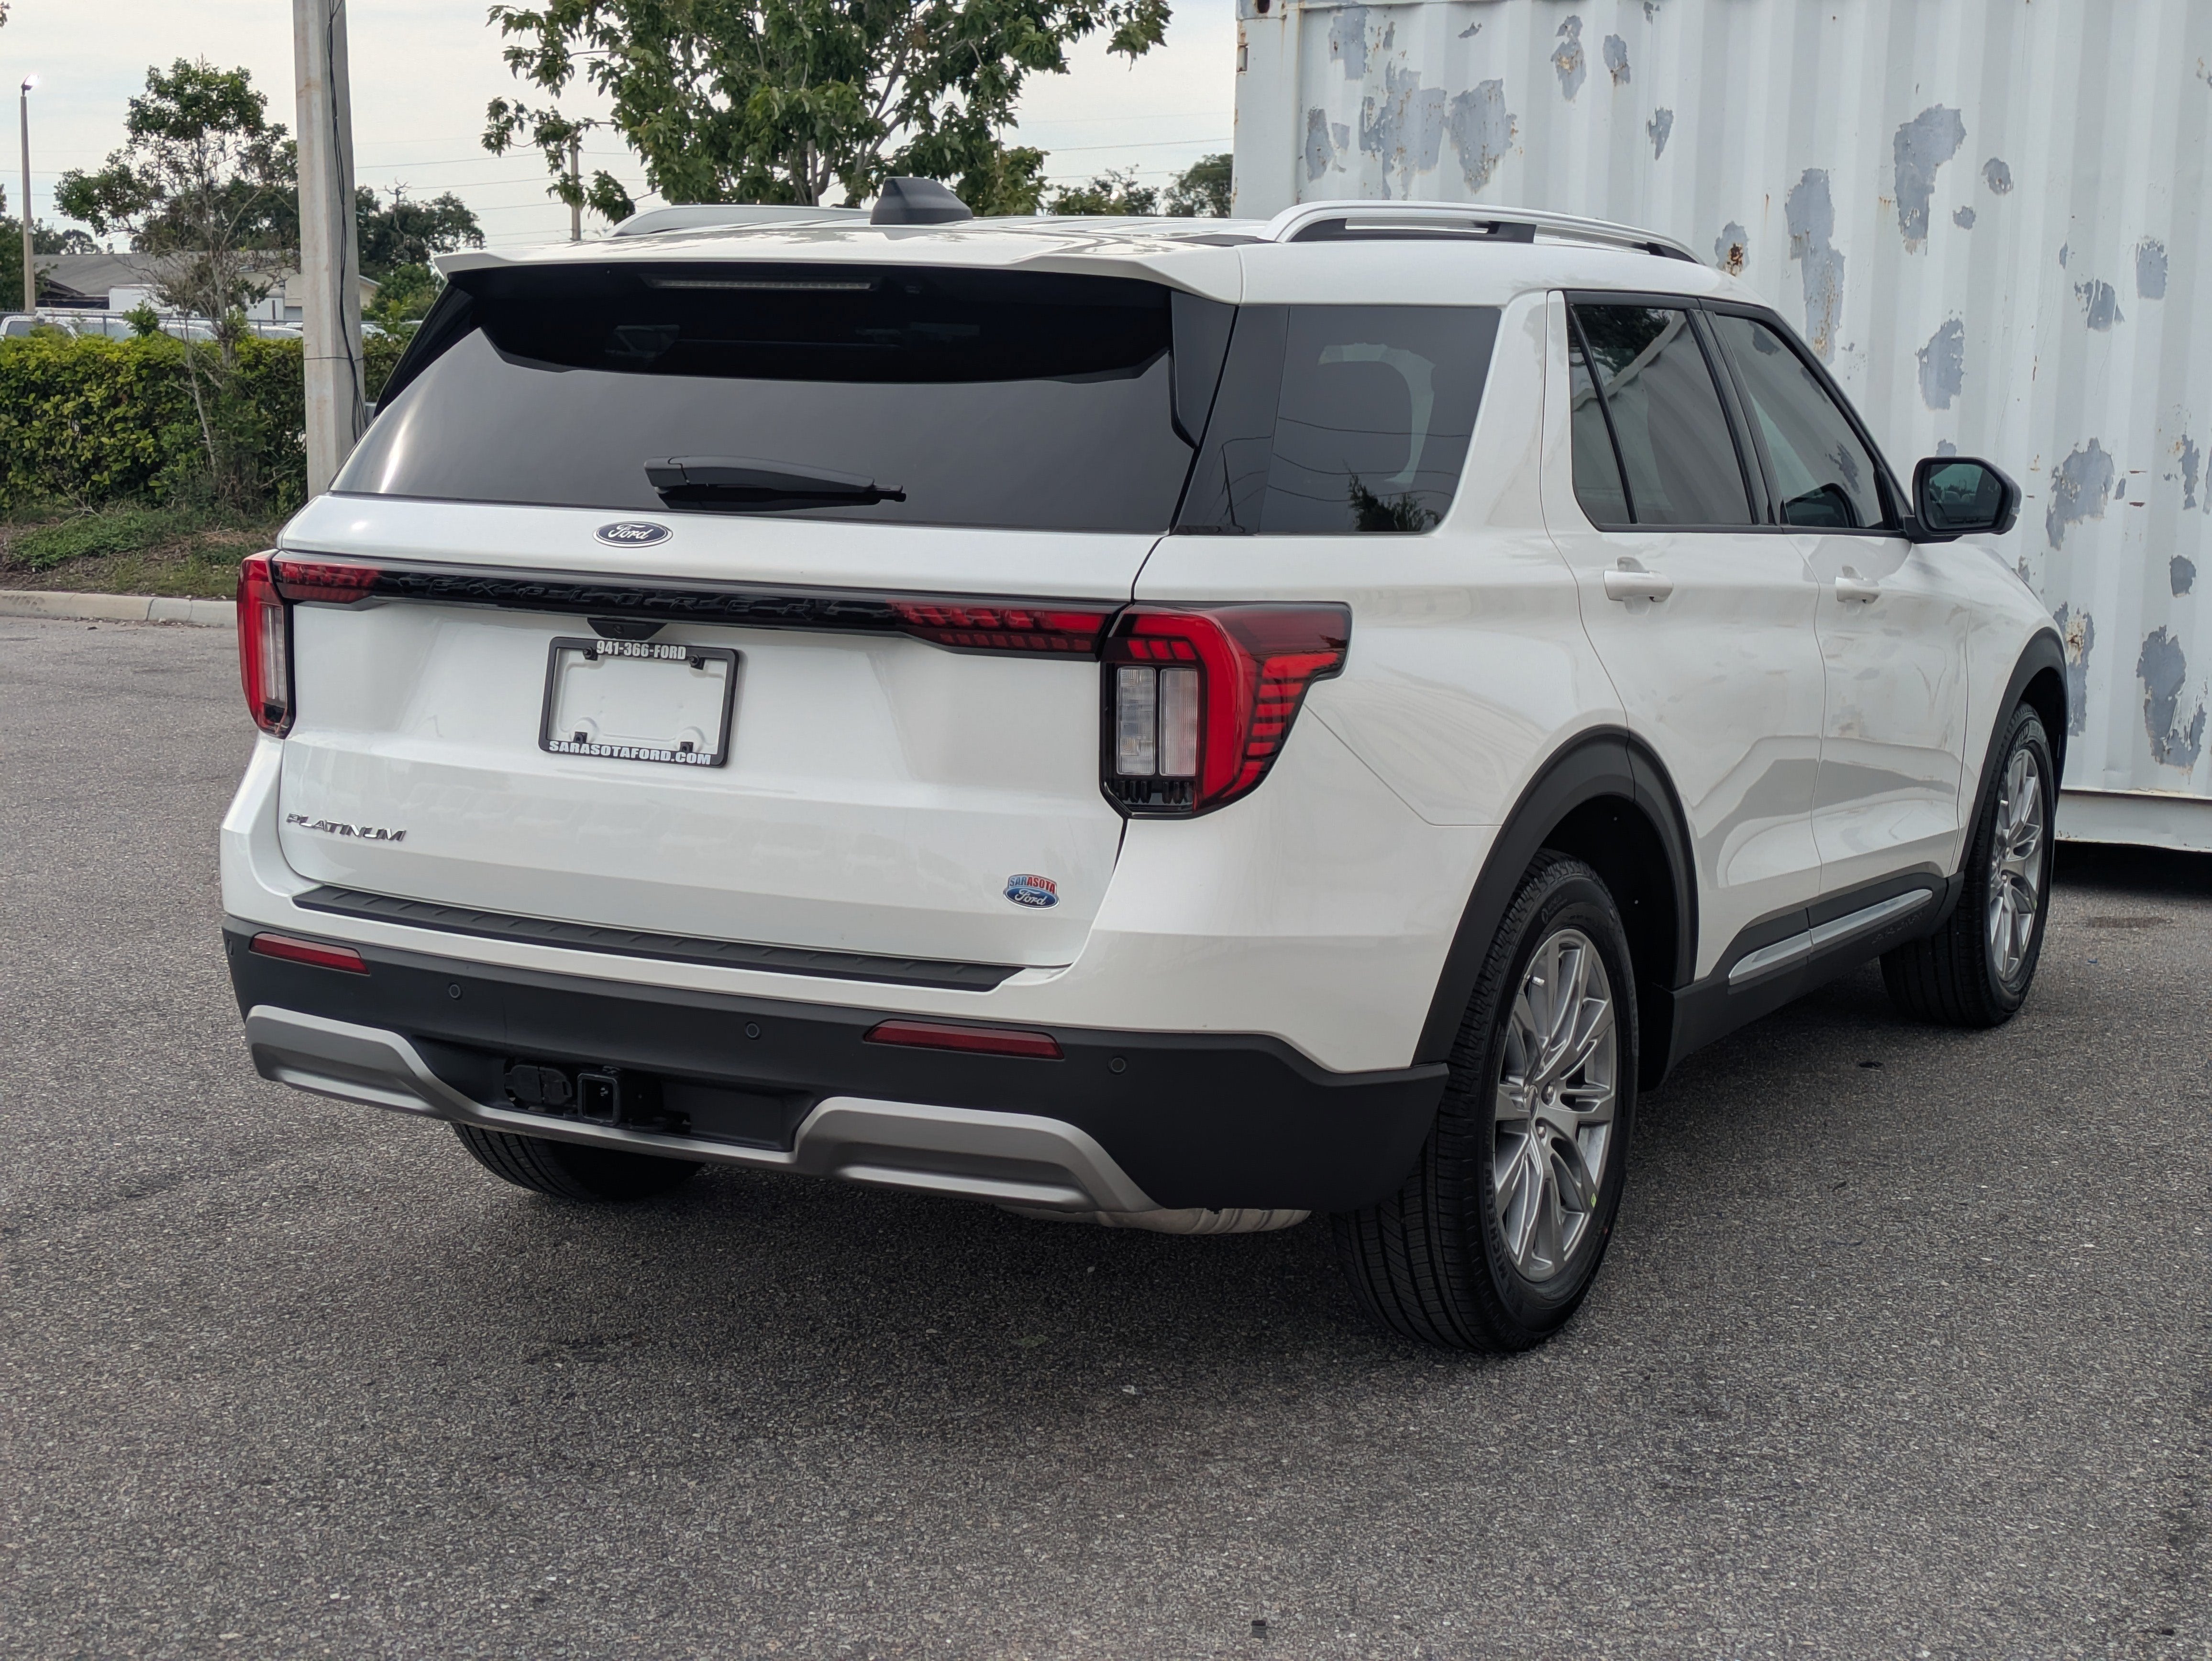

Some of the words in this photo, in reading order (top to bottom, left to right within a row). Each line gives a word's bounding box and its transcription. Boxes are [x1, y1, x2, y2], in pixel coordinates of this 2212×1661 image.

[608, 523, 652, 540] Ford
[596, 640, 686, 660] 941-366-FORD
[549, 740, 711, 765] SARASOTAFORD.COM
[286, 813, 407, 841] PLATINUM
[1009, 876, 1055, 894] SARASOTA
[1015, 888, 1048, 906] Ford
[1484, 1168, 1508, 1280] MICHELIN
